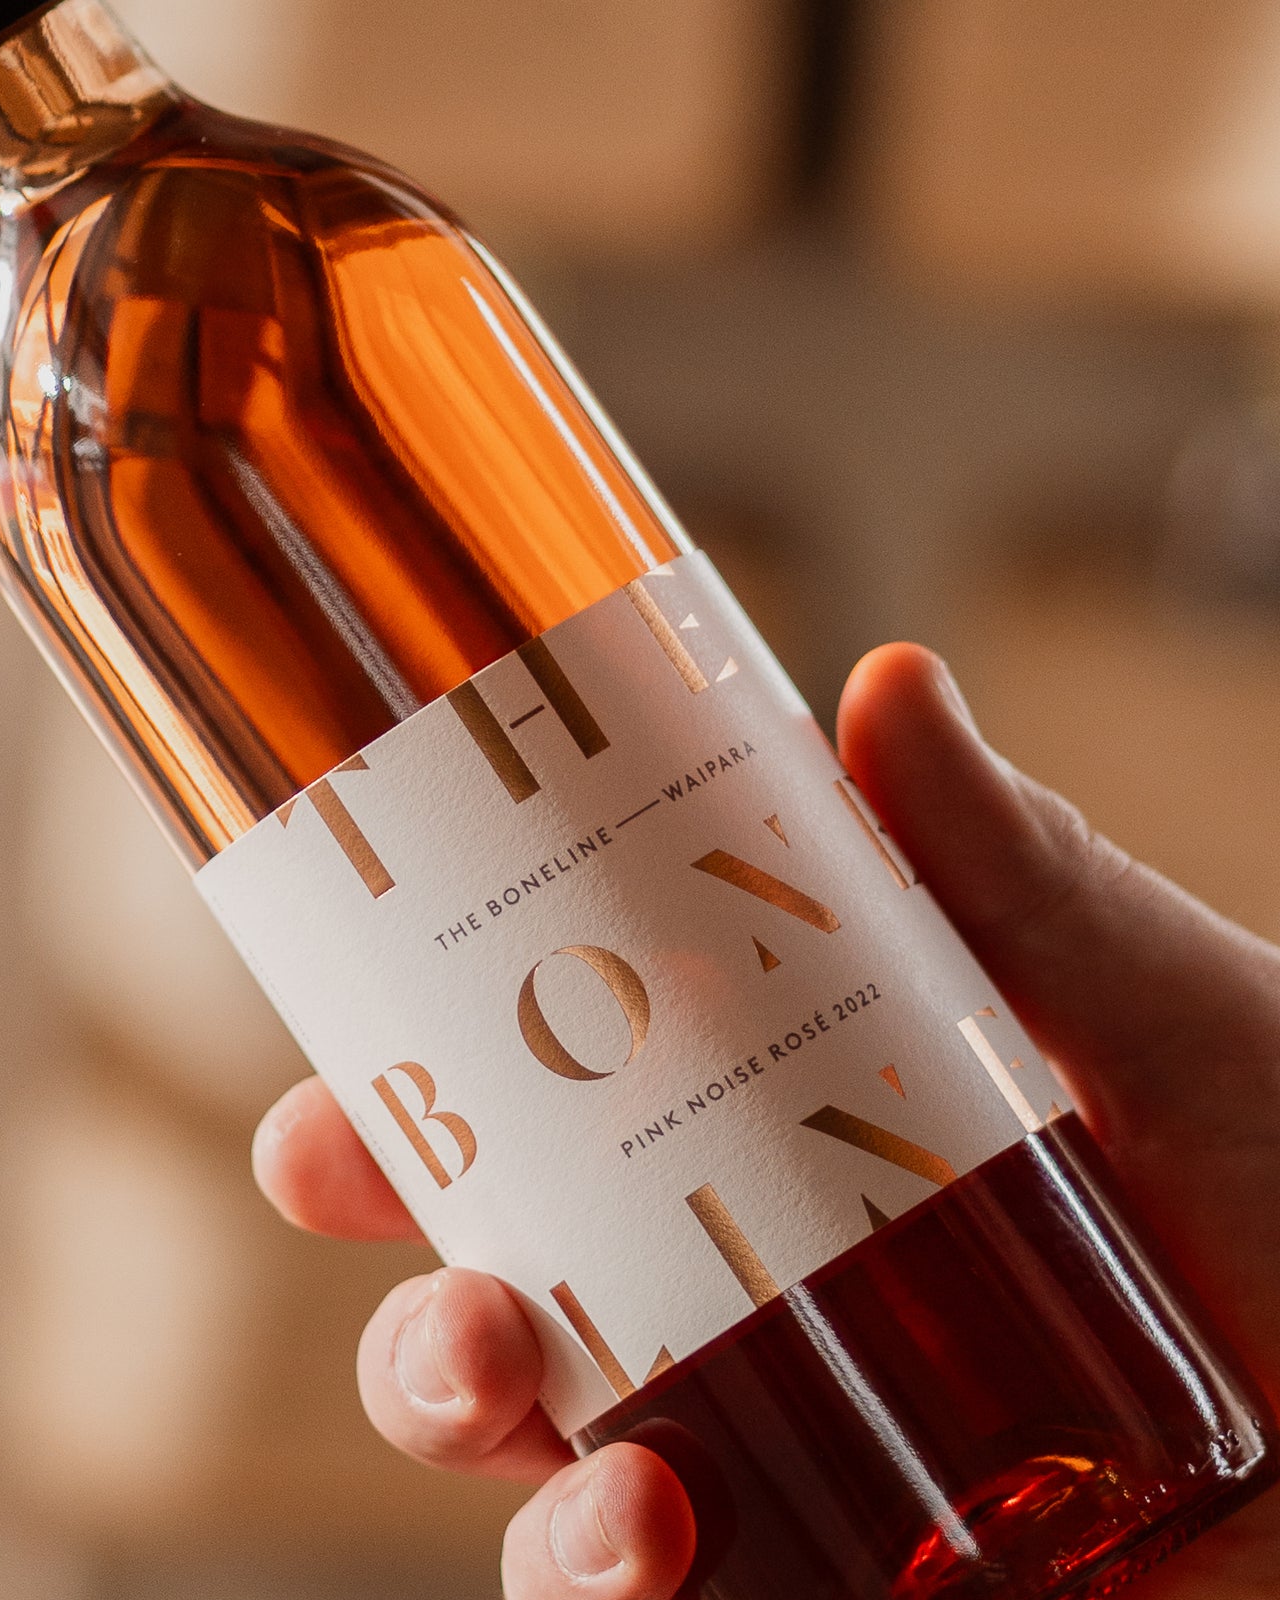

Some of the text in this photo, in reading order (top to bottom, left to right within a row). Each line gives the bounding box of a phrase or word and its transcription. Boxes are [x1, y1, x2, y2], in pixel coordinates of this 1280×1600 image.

[274, 562, 740, 900] THE
[434, 740, 757, 951] THE BONELINE WAIPARA
[620, 983, 881, 1158] PINK NOISE ROSÉ 2022
